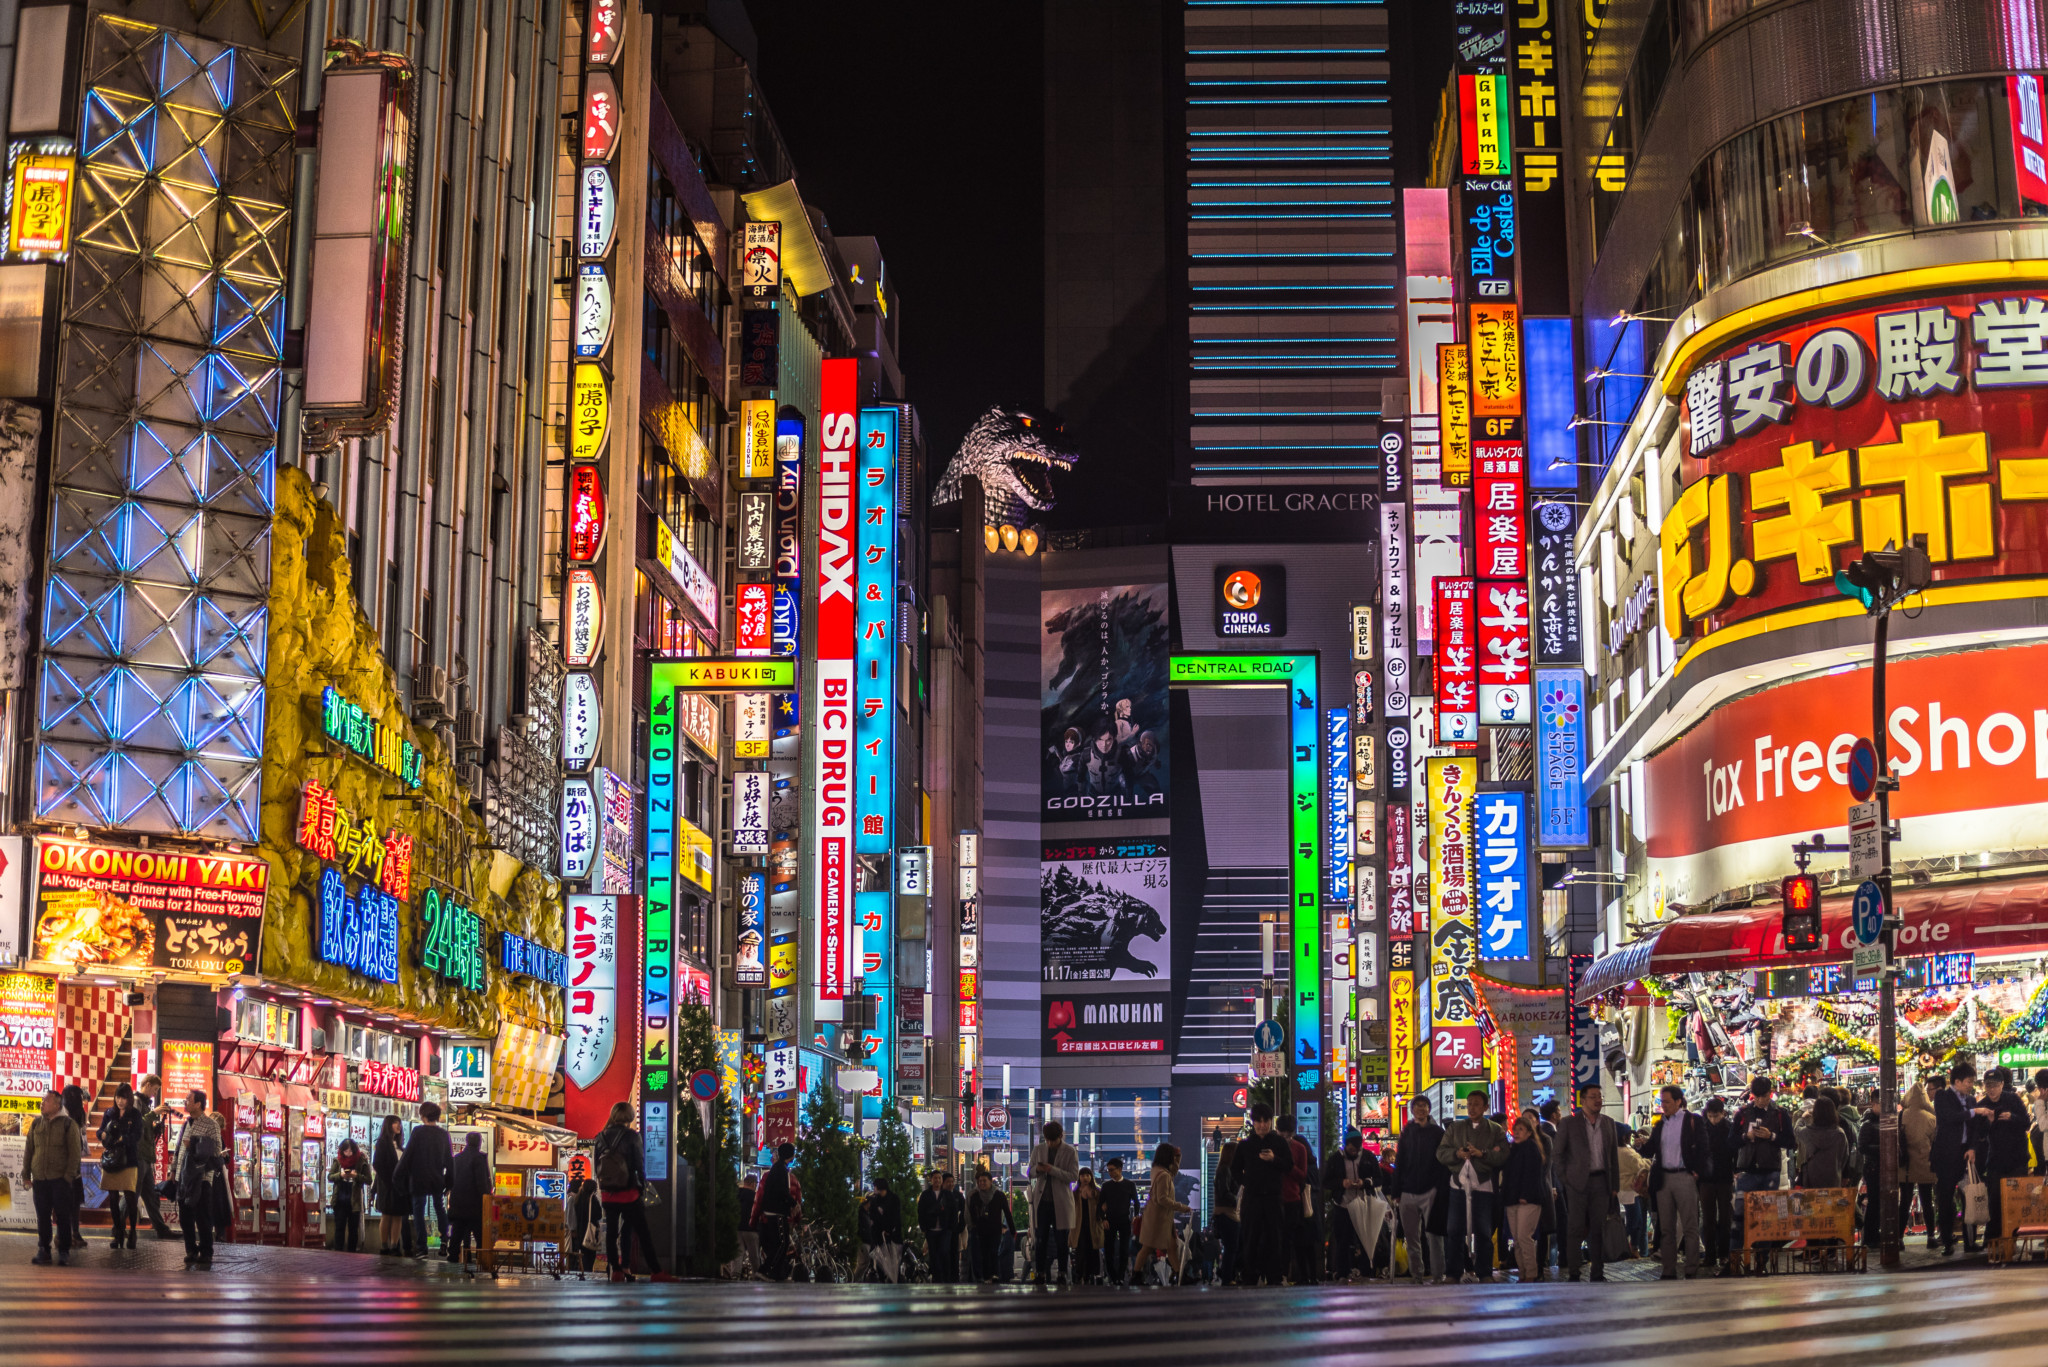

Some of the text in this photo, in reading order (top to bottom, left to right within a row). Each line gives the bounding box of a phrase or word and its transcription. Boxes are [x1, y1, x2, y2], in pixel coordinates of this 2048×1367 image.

[1458, 33, 1483, 50] CLUB
[1460, 30, 1506, 62] Way
[591, 53, 608, 62] 8F
[586, 92, 614, 138] つぼ八
[1479, 80, 1497, 153] Garam
[20, 156, 43, 167] 4F
[586, 148, 605, 157] 7F
[1470, 160, 1508, 171] ガラム
[1466, 180, 1488, 191] New
[28, 184, 56, 230] 虎の子
[588, 185, 603, 232] ヤキトリ
[748, 224, 768, 234] 海鮮
[748, 234, 776, 243] 居酒屋
[1470, 204, 1493, 276] Elle de
[1493, 193, 1514, 258] Castle
[581, 242, 604, 256] 6F
[753, 286, 768, 296] 8F
[1481, 282, 1507, 294] 7F
[581, 345, 596, 355] 5F
[1444, 348, 1455, 382] だいにんぐ
[1457, 348, 1468, 381] 炭火焼
[1476, 312, 1501, 400] わたみん家
[1502, 310, 1517, 393] 炭火焼だいにんぐ
[1687, 297, 2048, 458] 驚安の殿堂
[578, 389, 602, 436] 虎の子
[1447, 384, 1468, 459] わたみん家
[1485, 418, 1515, 436] 6F
[575, 445, 592, 454] 4F
[1380, 432, 1404, 492] Booth
[1476, 447, 1523, 458] 新しいタイプの
[1450, 473, 1470, 485] 6F
[1483, 461, 1520, 473] 居酒屋
[820, 413, 857, 604] SHIDAX
[1207, 493, 1280, 512] HOTEL
[743, 496, 767, 559] 山内農場
[1487, 482, 1520, 576] 居楽屋
[749, 558, 761, 567] 5F
[1388, 510, 1402, 650] ネットカフェ & カプセル
[1439, 581, 1474, 590] 新しいタイプの
[1444, 590, 1470, 599] 居酒屋
[1539, 534, 1563, 655] かんかん商店
[575, 585, 591, 655] お好み焼き
[753, 599, 768, 637] 焼肉屋
[1223, 612, 1258, 624] TOHO
[1223, 624, 1271, 634] CINEMAS
[1449, 601, 1464, 645] 居楽屋
[1610, 572, 1653, 657] Don Quijote
[863, 429, 888, 836] カラオケ&パーティー館
[1357, 616, 1369, 655] 東京ビル
[1480, 587, 1529, 682] 笑笑
[1176, 662, 1294, 674] CENTRAL ROAD
[1441, 646, 1473, 711] 笑笑
[574, 693, 588, 755] とらそば
[744, 742, 762, 754] 3F
[822, 678, 848, 827] BIC DRUG
[1386, 727, 1409, 789] Booth
[1548, 732, 1563, 790] STAGE
[1562, 732, 1576, 780] IDOL
[569, 759, 585, 769] 1F
[1703, 757, 1745, 823] Tax
[1755, 732, 1860, 804] Free
[566, 787, 587, 797] 新宿
[743, 774, 762, 829] お好み焼
[1047, 792, 1164, 809] GODZILLA
[1331, 716, 1349, 894] 747 カラオケランド
[566, 797, 588, 854] かっぱ
[1441, 764, 1465, 889] きんくら酒場
[1550, 808, 1576, 826] 5F
[1852, 804, 1876, 821] 20-7
[1394, 807, 1406, 863] 手作り居酒屋
[44, 845, 267, 890] OKONOMI YAKI
[567, 859, 584, 871] B1
[646, 724, 672, 1029] GODZILLA ROAD
[1081, 859, 1168, 875] 歴代最大ゴジラ
[1295, 743, 1316, 1007] ゴジラロード
[1484, 799, 1522, 951] カラオケ
[43, 873, 263, 905] All-You-Can-Eat dinner with Free-Flowing
[1143, 874, 1169, 889] 現る
[1444, 889, 1463, 898] KIN
[1859, 883, 1874, 895] 7-20
[129, 895, 262, 918] Drinks for 2 hours ¥2,700
[741, 876, 760, 927] 海の家
[1388, 865, 1412, 933] 甘太郎
[1444, 904, 1468, 913] KURA
[321, 866, 399, 985] 飲み放題
[598, 898, 615, 963] 大衆酒場
[826, 841, 839, 995] BIC CAMERA SHIDAX
[1858, 896, 1871, 937] P
[1867, 915, 1877, 934] 40
[422, 886, 485, 991] 24時間
[1391, 943, 1412, 955] 4F
[1840, 918, 1950, 951] Qjote
[170, 957, 241, 973] TORADYU 2F
[572, 905, 597, 1016] トラノコ
[1391, 955, 1412, 968] 3F
[1433, 919, 1475, 1021] 金の蔵
[961, 974, 976, 997] 麻雀
[1809, 966, 1841, 994] 2F
[34, 993, 56, 1003] YAKI
[900, 1020, 923, 1031] Cafe
[1083, 1003, 1163, 1024] MARUHAN
[1496, 1010, 1566, 1023] KARAOKE 747
[1815, 1004, 1850, 1027] MERRY
[163, 1042, 212, 1053] OKONOMI
[175, 1052, 201, 1064] YAKI
[1061, 1041, 1159, 1053] 2F店舗出入口はビル左側
[363, 1059, 420, 1102] カラオケBOX
[773, 1050, 787, 1089] 牛かつ
[903, 1069, 921, 1077] 729
[5, 1078, 50, 1094] 2,300円
[450, 1086, 488, 1099] 虎の子
[768, 1117, 793, 1128] アダム
[508, 1139, 550, 1152] トラノコ
